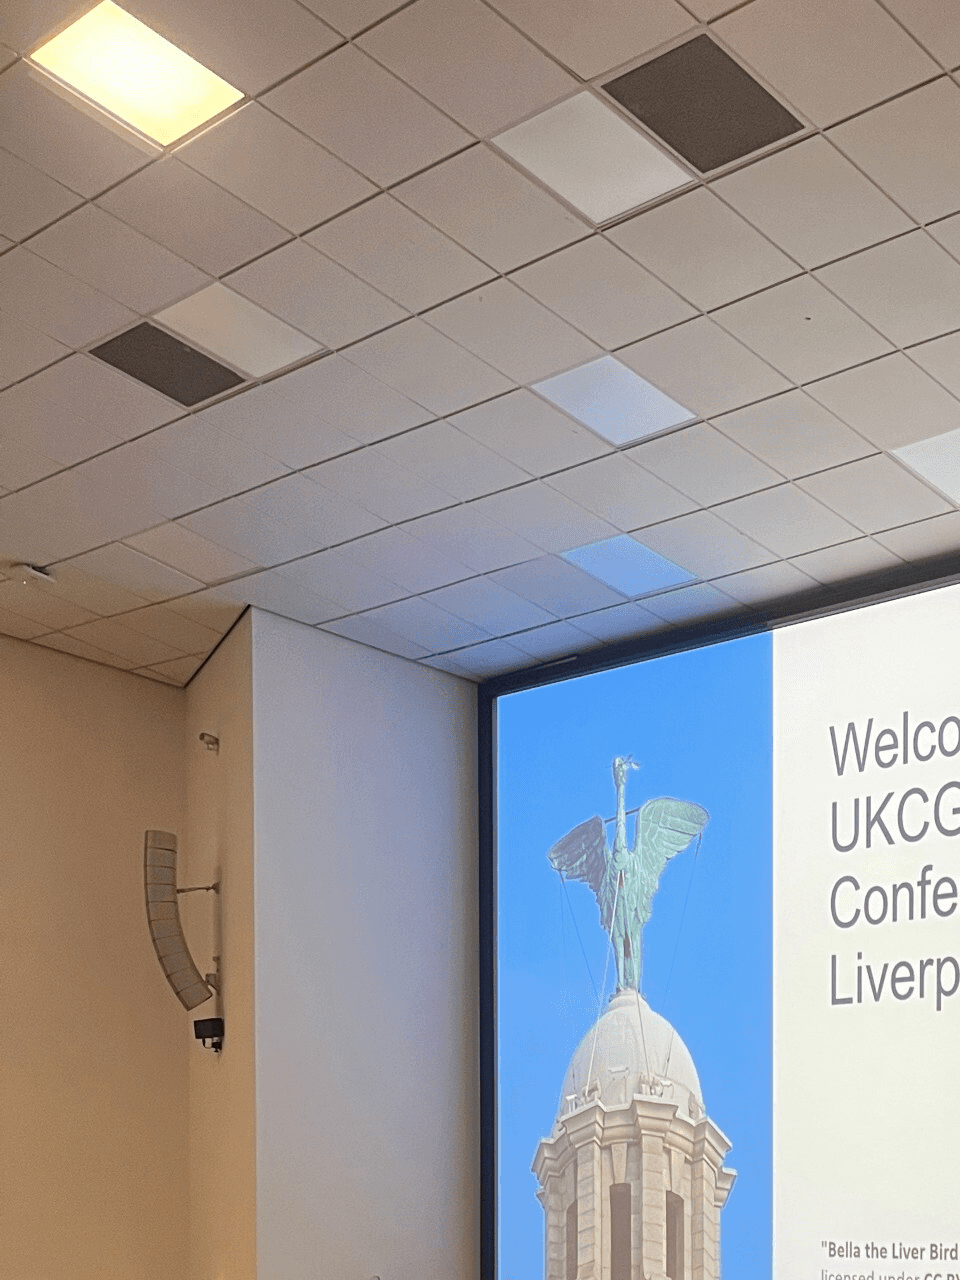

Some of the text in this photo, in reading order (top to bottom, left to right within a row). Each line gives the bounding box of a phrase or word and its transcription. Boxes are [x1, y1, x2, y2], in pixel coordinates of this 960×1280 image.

[821, 1240, 861, 1259] "Bella
[865, 1242, 888, 1260] the
[892, 1242, 925, 1260] Liver
